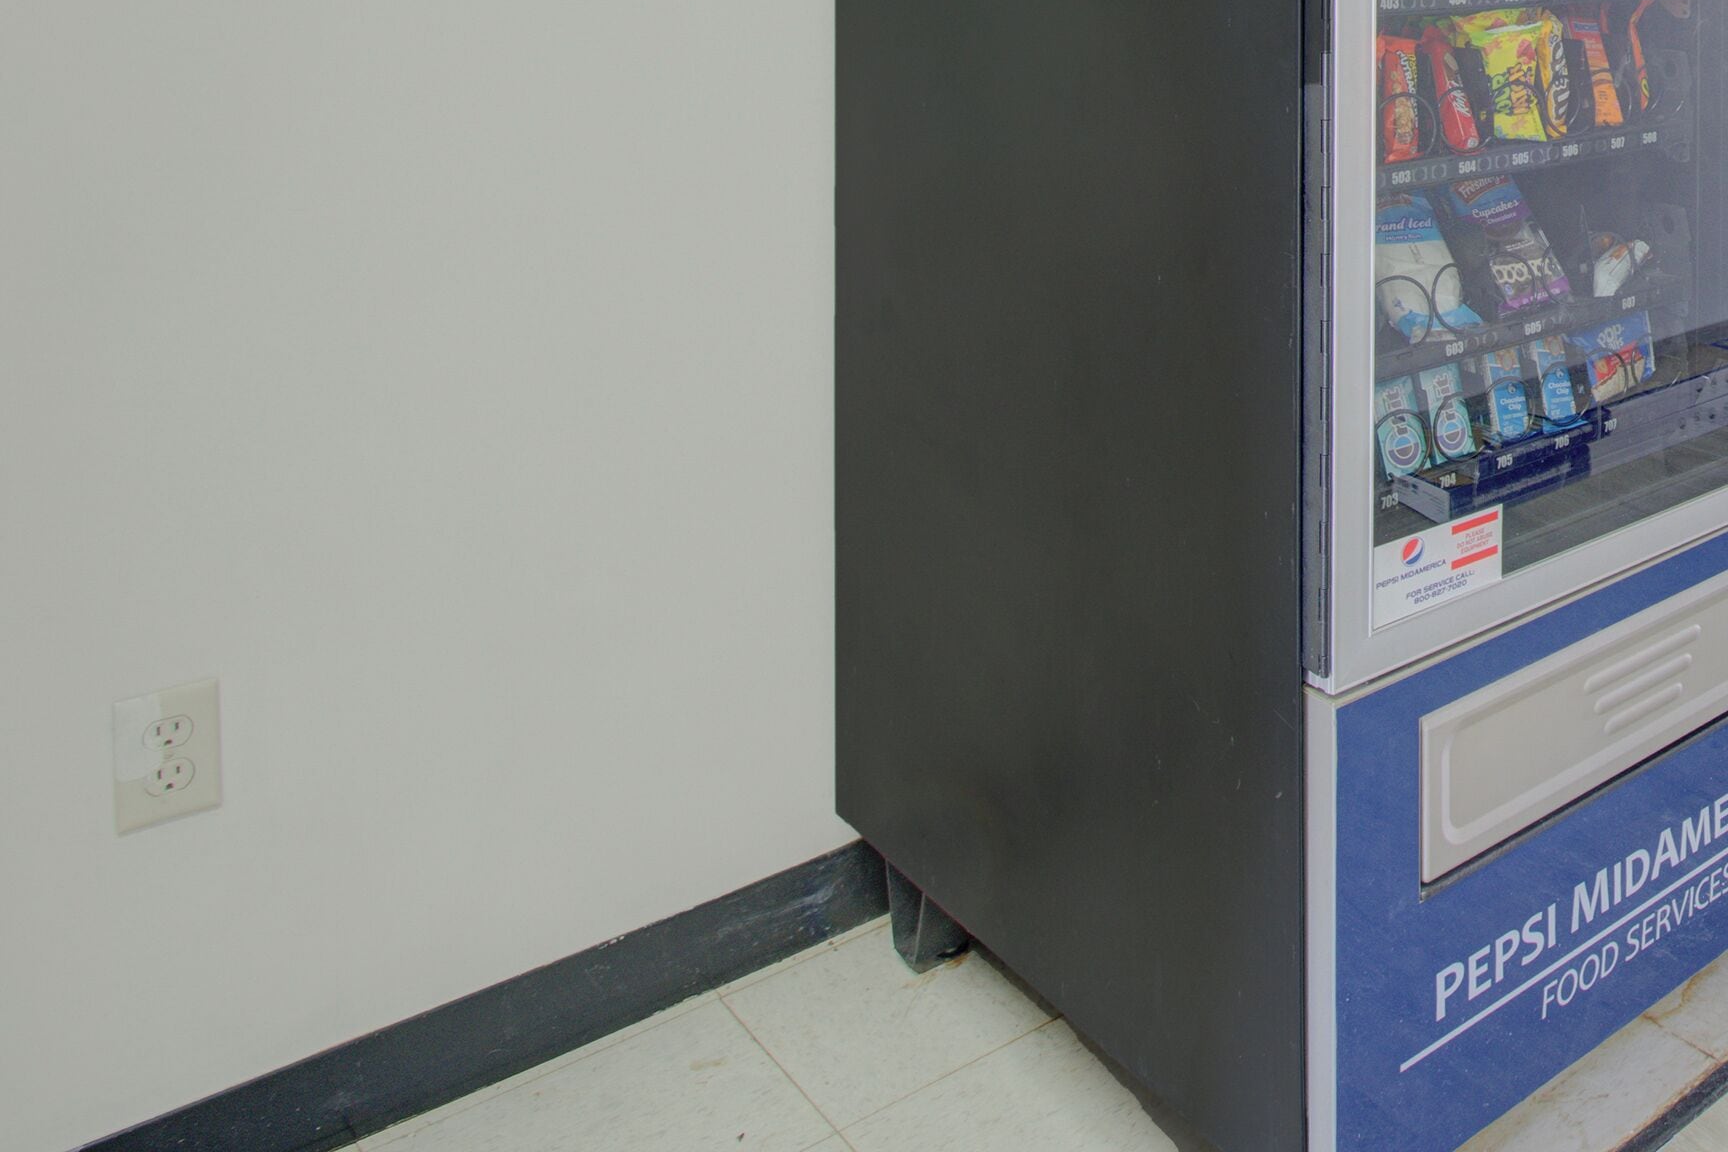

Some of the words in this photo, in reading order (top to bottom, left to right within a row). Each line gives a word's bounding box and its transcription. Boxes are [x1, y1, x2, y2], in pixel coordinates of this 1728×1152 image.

[1562, 143, 1578, 156] 506
[1611, 136, 1625, 149] 507
[1512, 151, 1529, 165] 505
[1458, 160, 1476, 174] 504
[1391, 170, 1410, 184] 503
[1472, 199, 1519, 219] Cupcakes
[1407, 216, 1432, 229] Iced
[1524, 320, 1541, 336] 605
[1445, 341, 1463, 357] 603
[1604, 418, 1617, 432] 707
[1554, 434, 1570, 450] 706
[1496, 454, 1513, 470] 705
[1439, 472, 1456, 488] 704
[1381, 492, 1398, 509] 703
[1376, 575, 1399, 590] PEPSI
[1400, 558, 1446, 581] MIDAMERICA
[1406, 588, 1422, 600] FOR
[1423, 576, 1454, 592] SERVICE
[1435, 902, 1557, 1022] PEPSI
[1541, 940, 1619, 1019] FOOD
